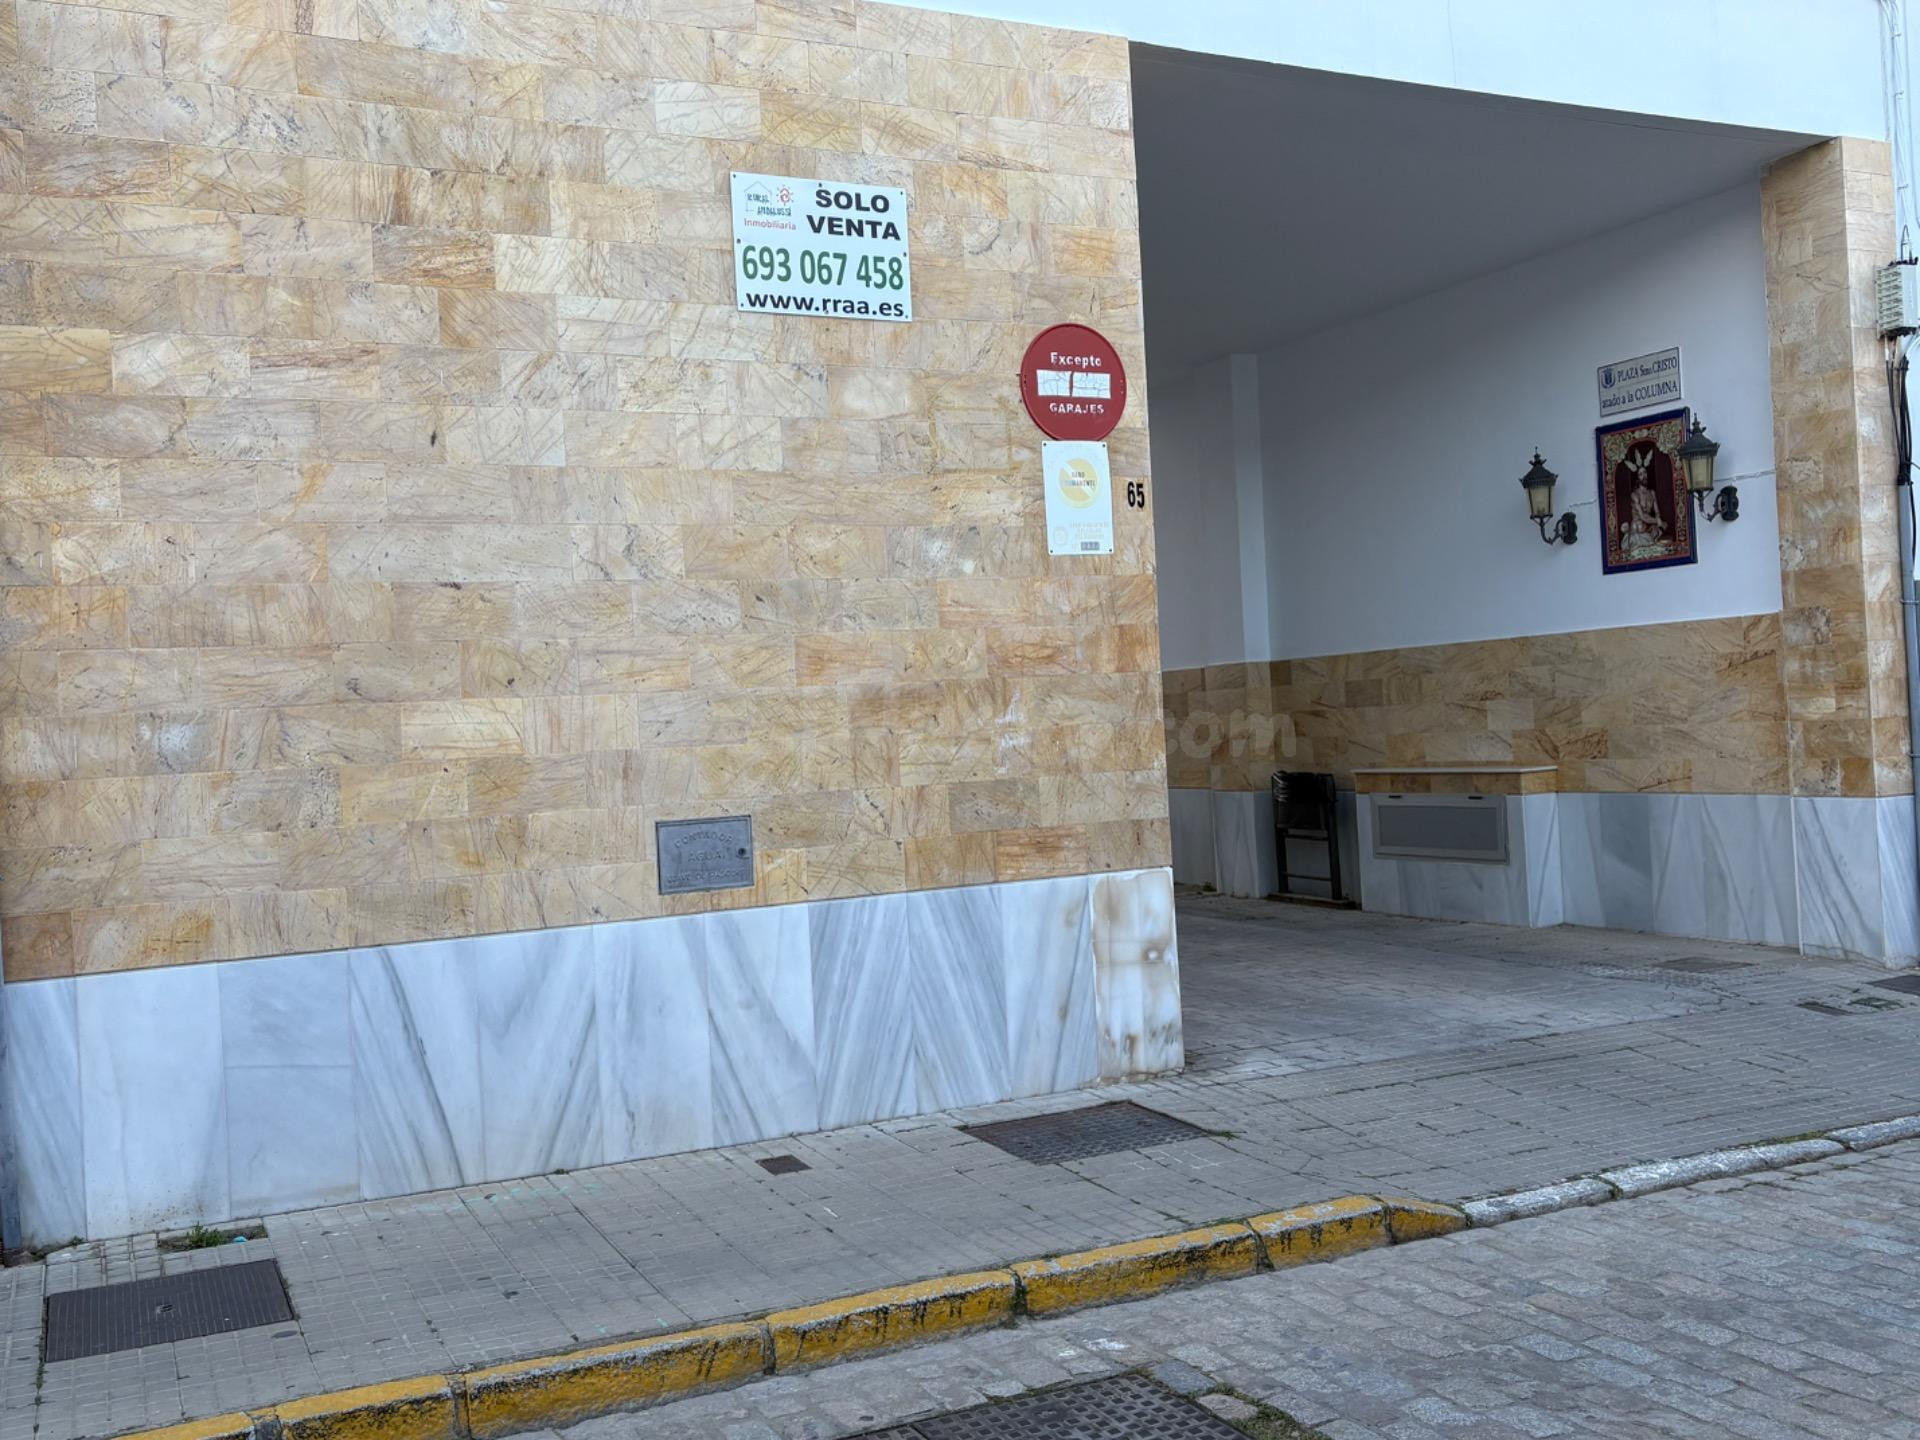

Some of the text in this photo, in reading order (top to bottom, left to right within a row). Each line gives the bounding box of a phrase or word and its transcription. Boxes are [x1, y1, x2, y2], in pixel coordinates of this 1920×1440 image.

[815, 189, 890, 213] SOLO
[744, 218, 796, 231] Inmobiliaria
[806, 215, 901, 241] VENTA
[742, 245, 903, 290] 693 067 458
[746, 293, 904, 317] www.rraa.es
[1051, 351, 1101, 369] Excepto
[1617, 366, 1639, 383] PLAZA
[1652, 356, 1678, 373] CRISTO
[1635, 380, 1678, 401] COLUMNA
[1050, 402, 1104, 414] GARAJES
[1127, 481, 1145, 508] 65
